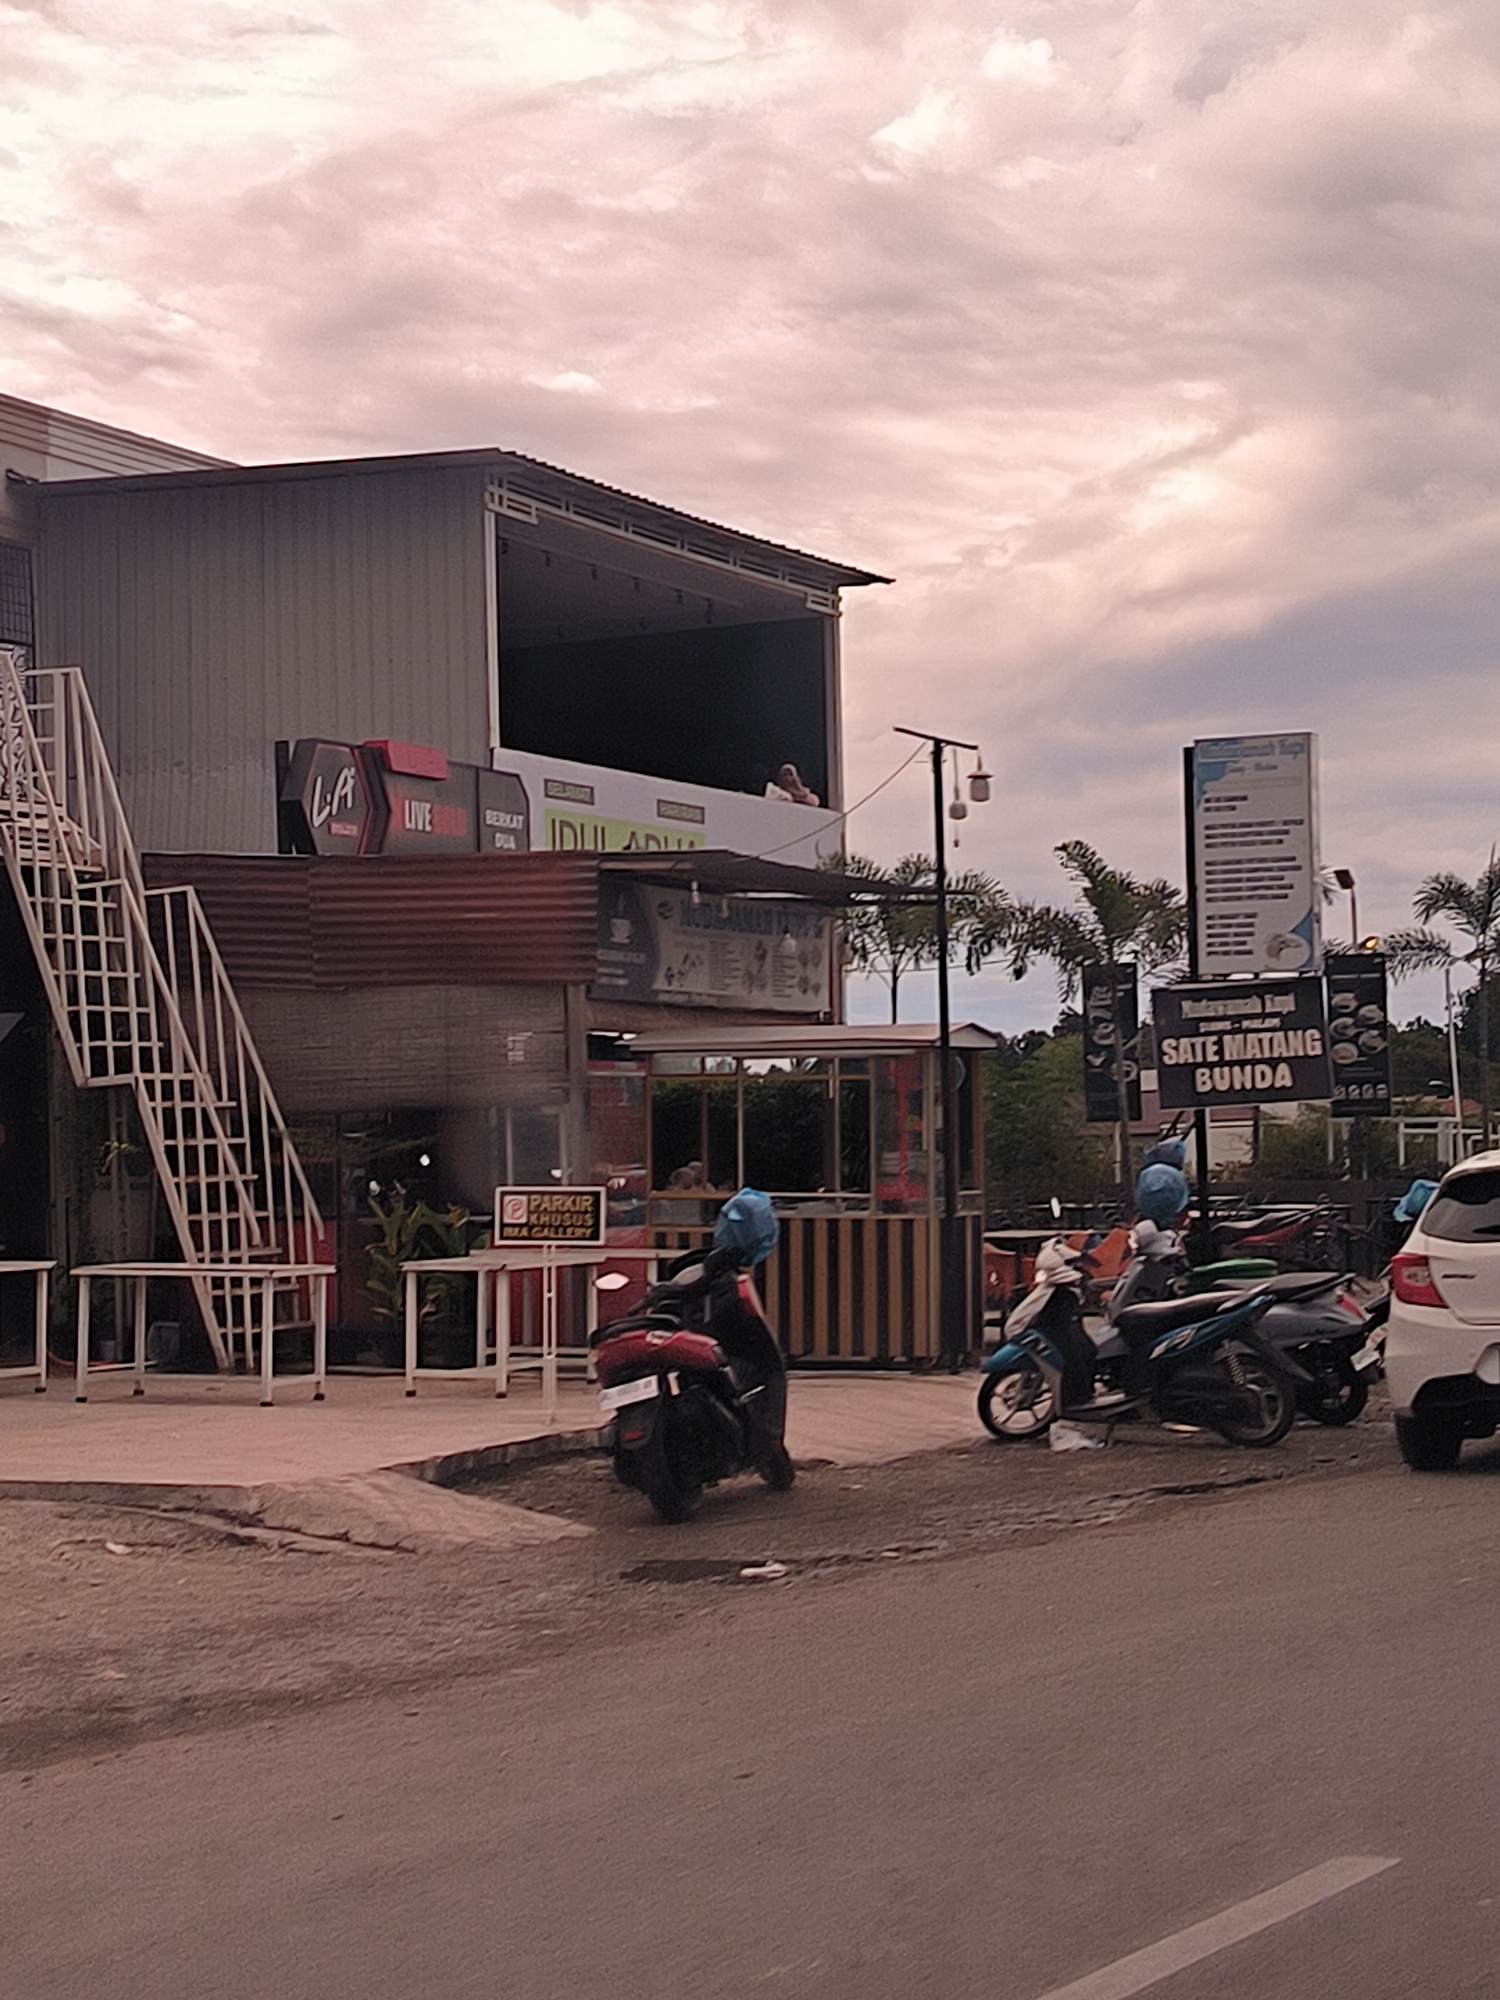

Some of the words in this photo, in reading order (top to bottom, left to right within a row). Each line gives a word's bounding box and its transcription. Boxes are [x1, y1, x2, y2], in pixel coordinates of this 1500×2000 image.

[404, 799, 433, 832] LIVE
[485, 808, 525, 831] BERKAT
[1161, 1036, 1221, 1066] SATE
[1222, 1028, 1323, 1062] MATANG
[1194, 1062, 1293, 1093] BUNDA
[529, 1194, 594, 1212] PARKIR
[529, 1212, 594, 1226] KHUSUS
[530, 1226, 595, 1239] GALLERY
